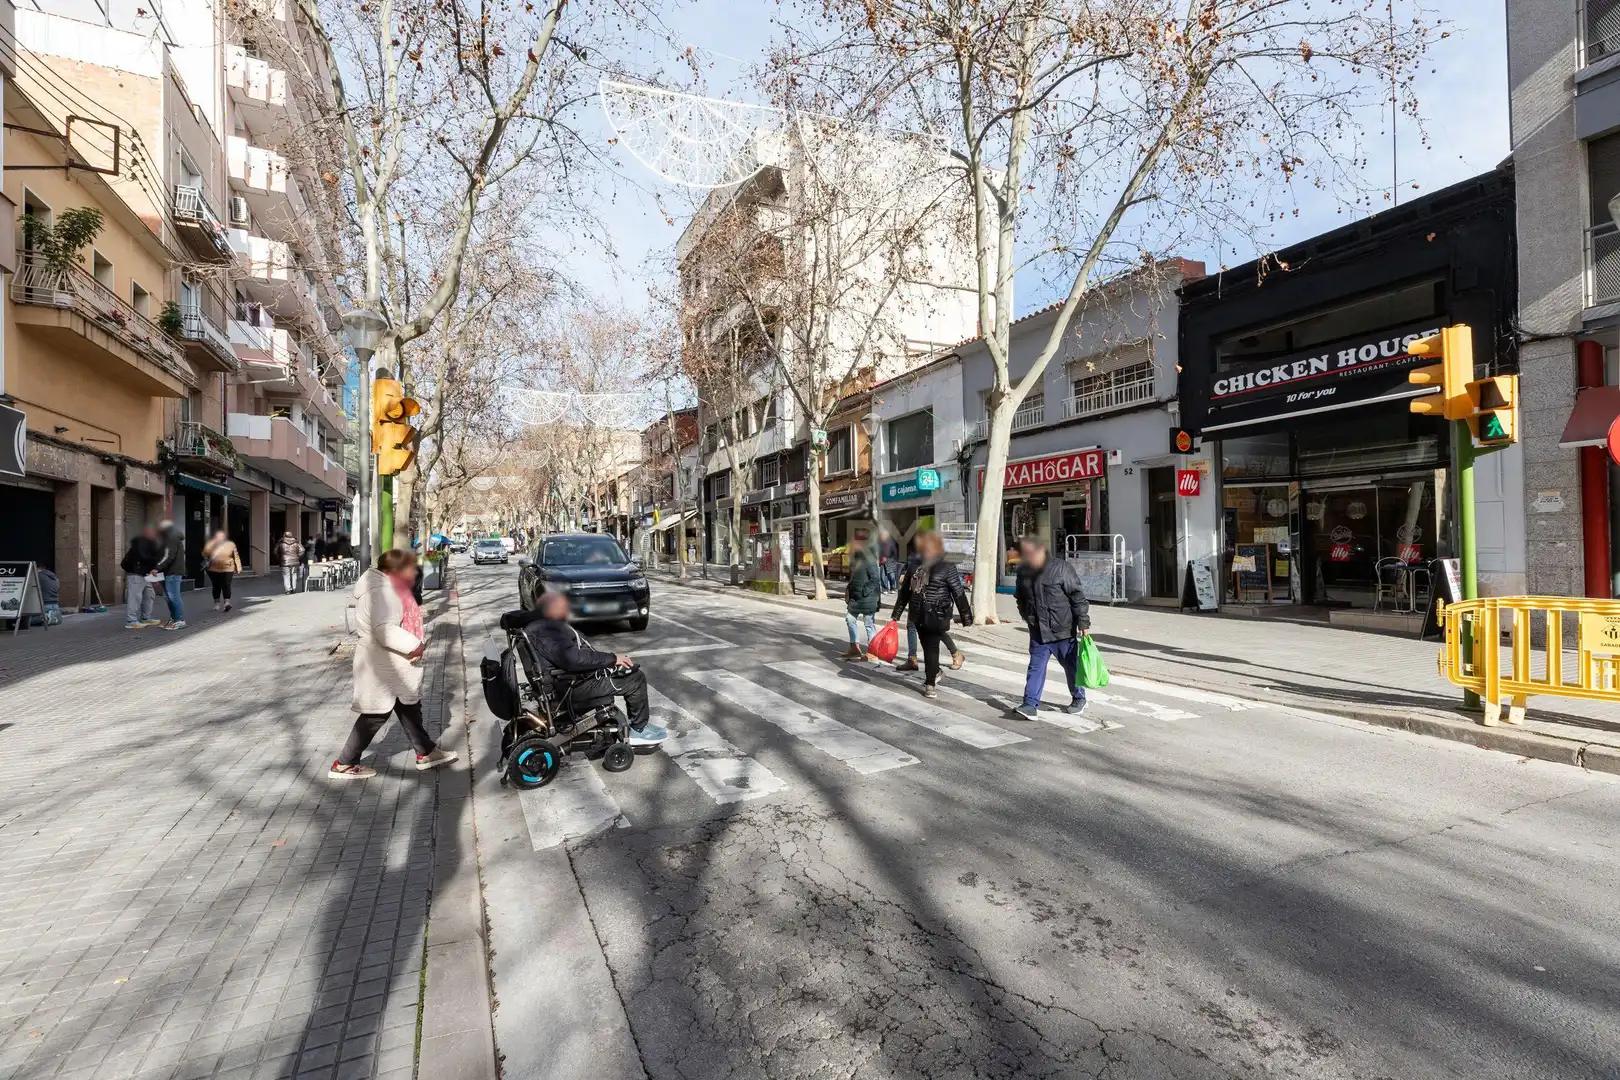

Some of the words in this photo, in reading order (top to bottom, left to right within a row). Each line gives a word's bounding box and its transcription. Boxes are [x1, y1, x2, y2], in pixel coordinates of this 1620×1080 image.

[1213, 355, 1330, 396] CHICKEN
[1339, 363, 1389, 377] RESTAURANT
[1286, 394, 1296, 403] 10
[1297, 391, 1315, 402] for
[1315, 386, 1336, 399] you
[1124, 467, 1133, 476] 52
[897, 484, 918, 496] cajama
[1180, 473, 1199, 494] illy
[1332, 547, 1349, 560] illy
[1400, 547, 1420, 561] illy
